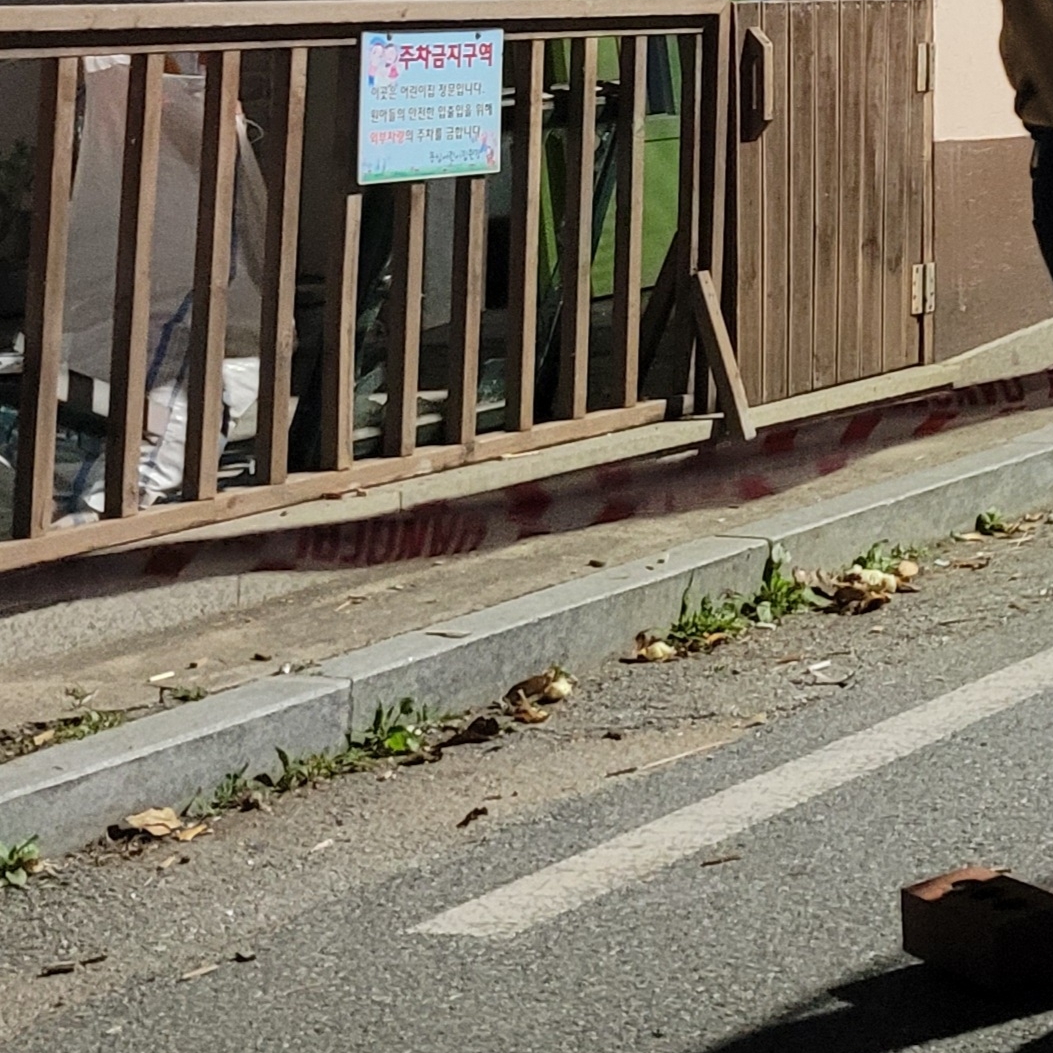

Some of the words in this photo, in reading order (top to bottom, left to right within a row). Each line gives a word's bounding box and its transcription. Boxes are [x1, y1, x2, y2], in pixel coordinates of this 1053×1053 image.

[399, 43, 492, 69] 주차금지구역
[371, 85, 397, 100] 이곳은
[401, 84, 435, 98] 어린이집
[439, 82, 485, 97] 정문입니다.
[371, 106, 405, 123] 원아들의
[408, 105, 434, 121] 안전한
[476, 103, 493, 117] 위해
[417, 128, 442, 143] 주차를
